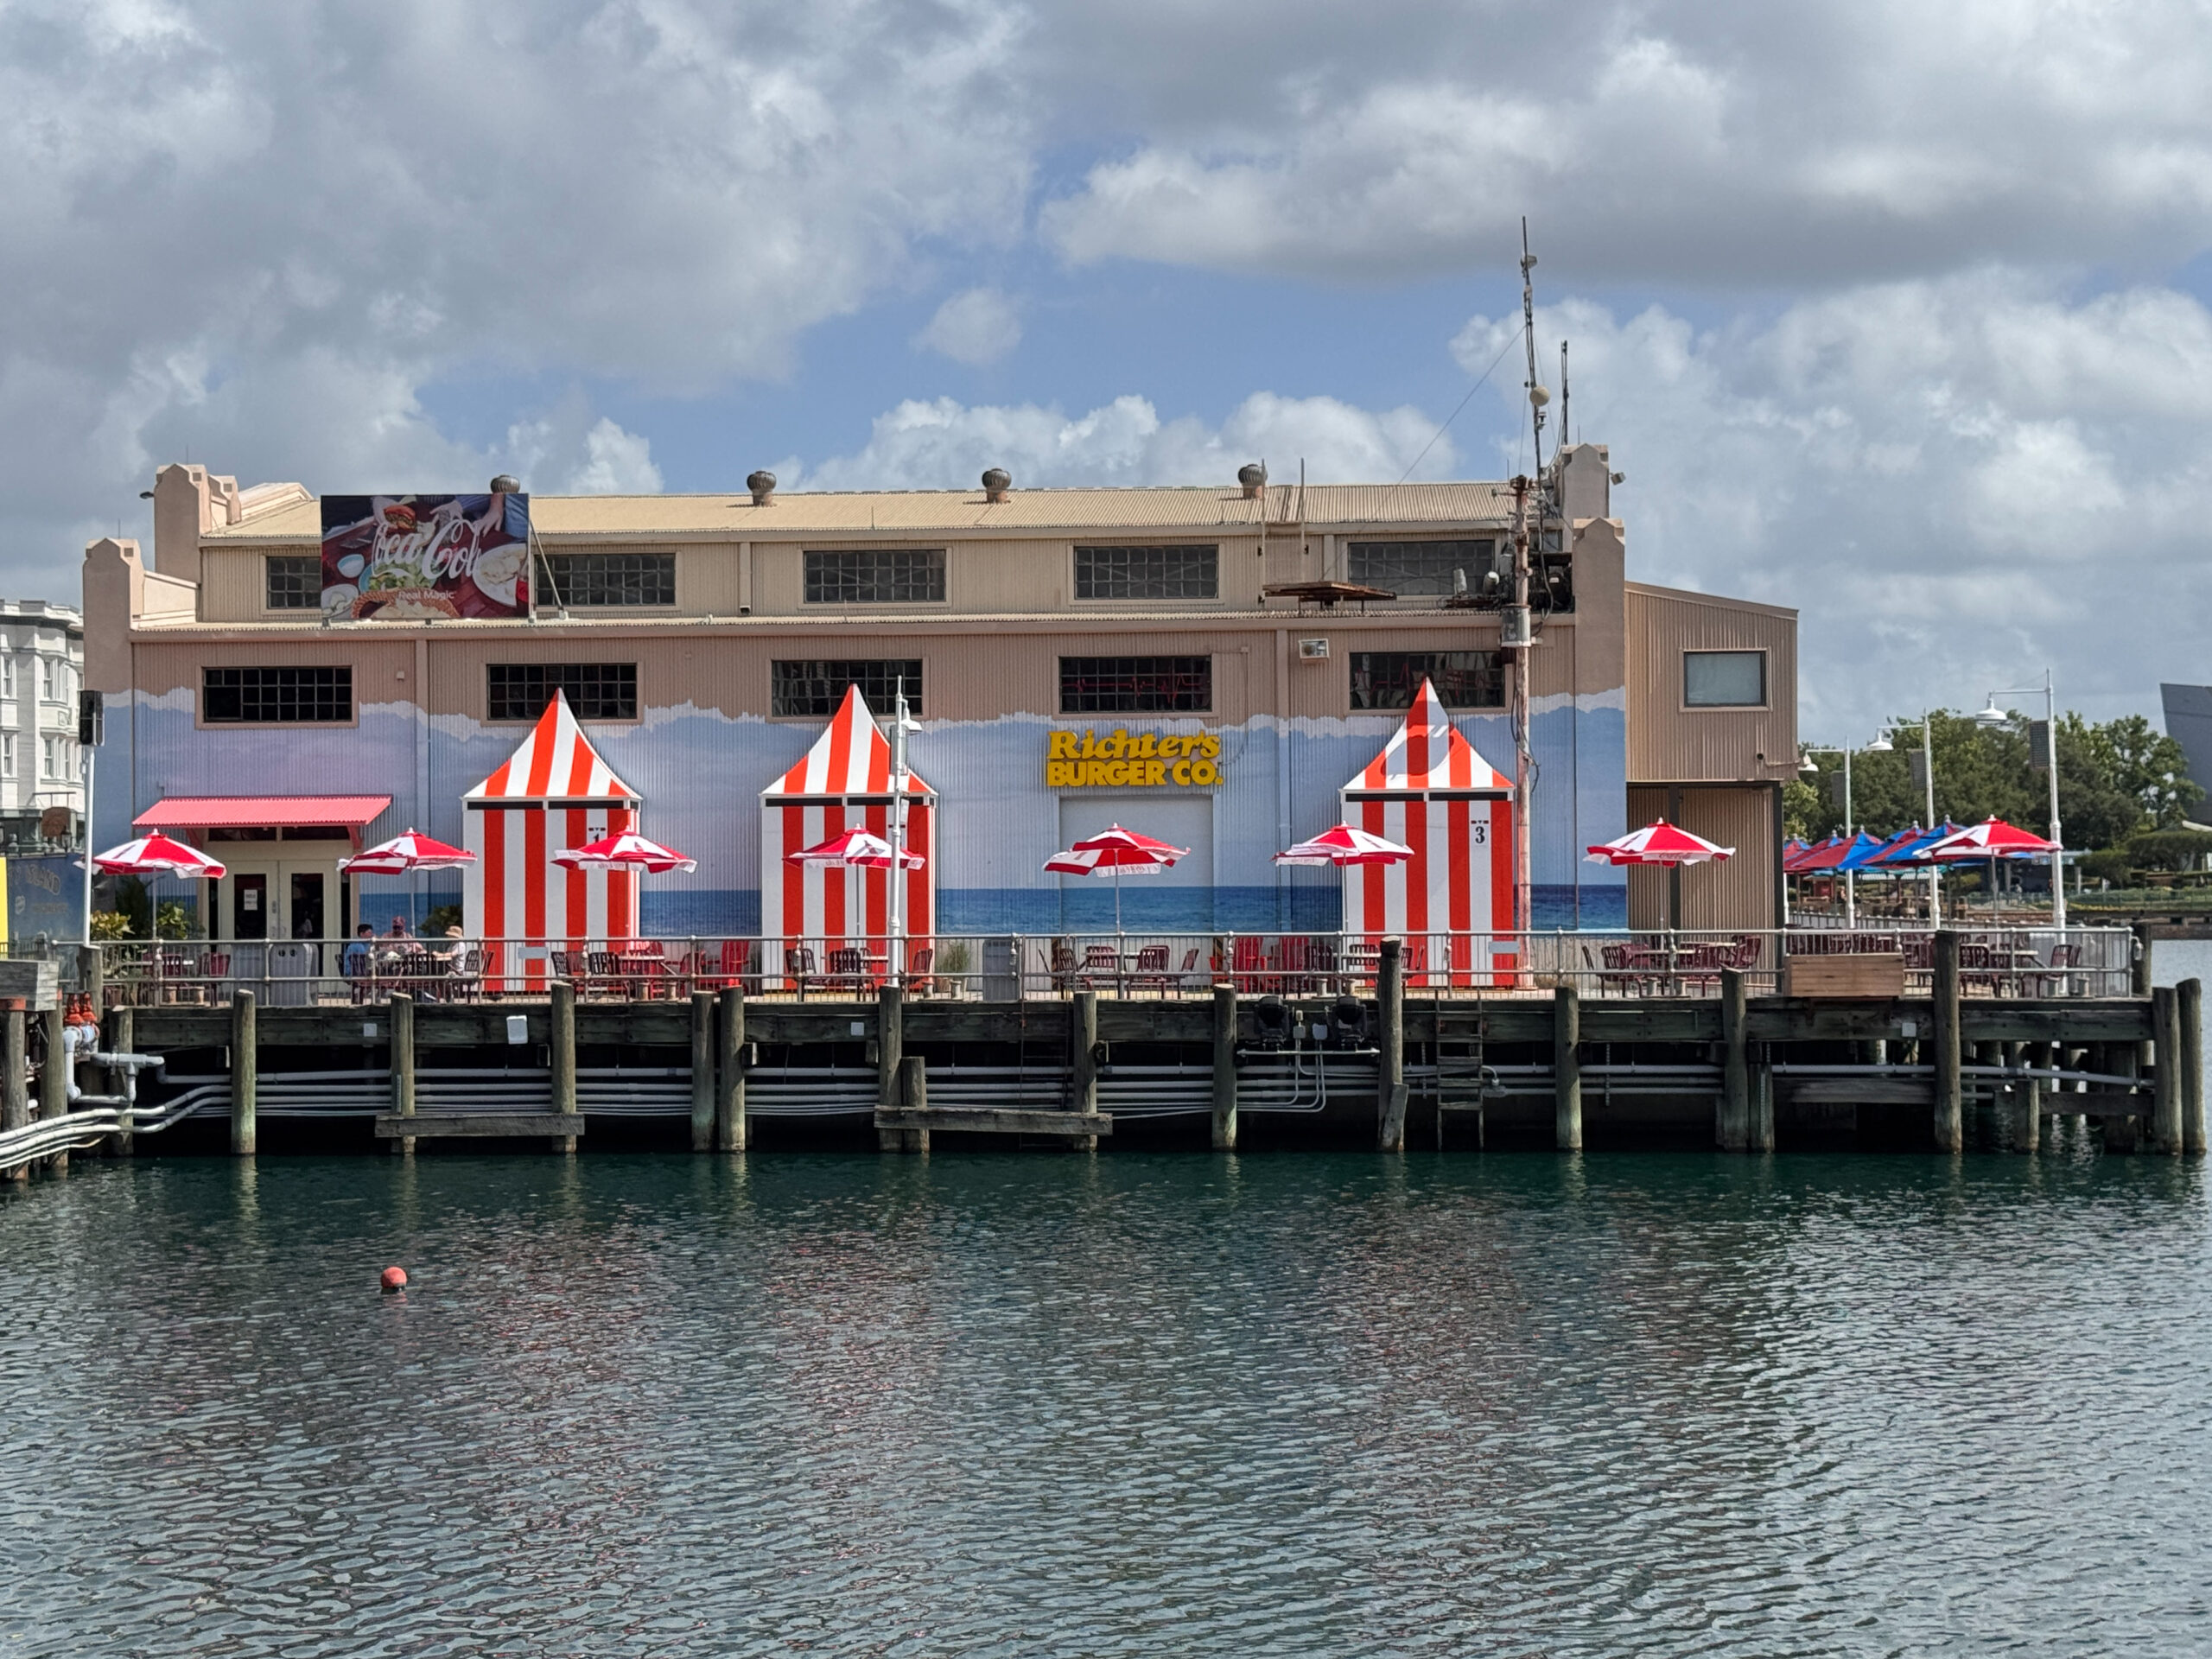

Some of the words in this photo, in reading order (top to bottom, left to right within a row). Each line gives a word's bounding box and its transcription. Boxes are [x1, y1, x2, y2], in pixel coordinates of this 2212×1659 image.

[398, 590, 421, 600] Real
[423, 590, 455, 601] Magic
[1047, 728, 1221, 760] Richter's
[1047, 760, 1166, 786] BURGER
[1172, 759, 1224, 786] CO.
[1475, 825, 1485, 844] 3
